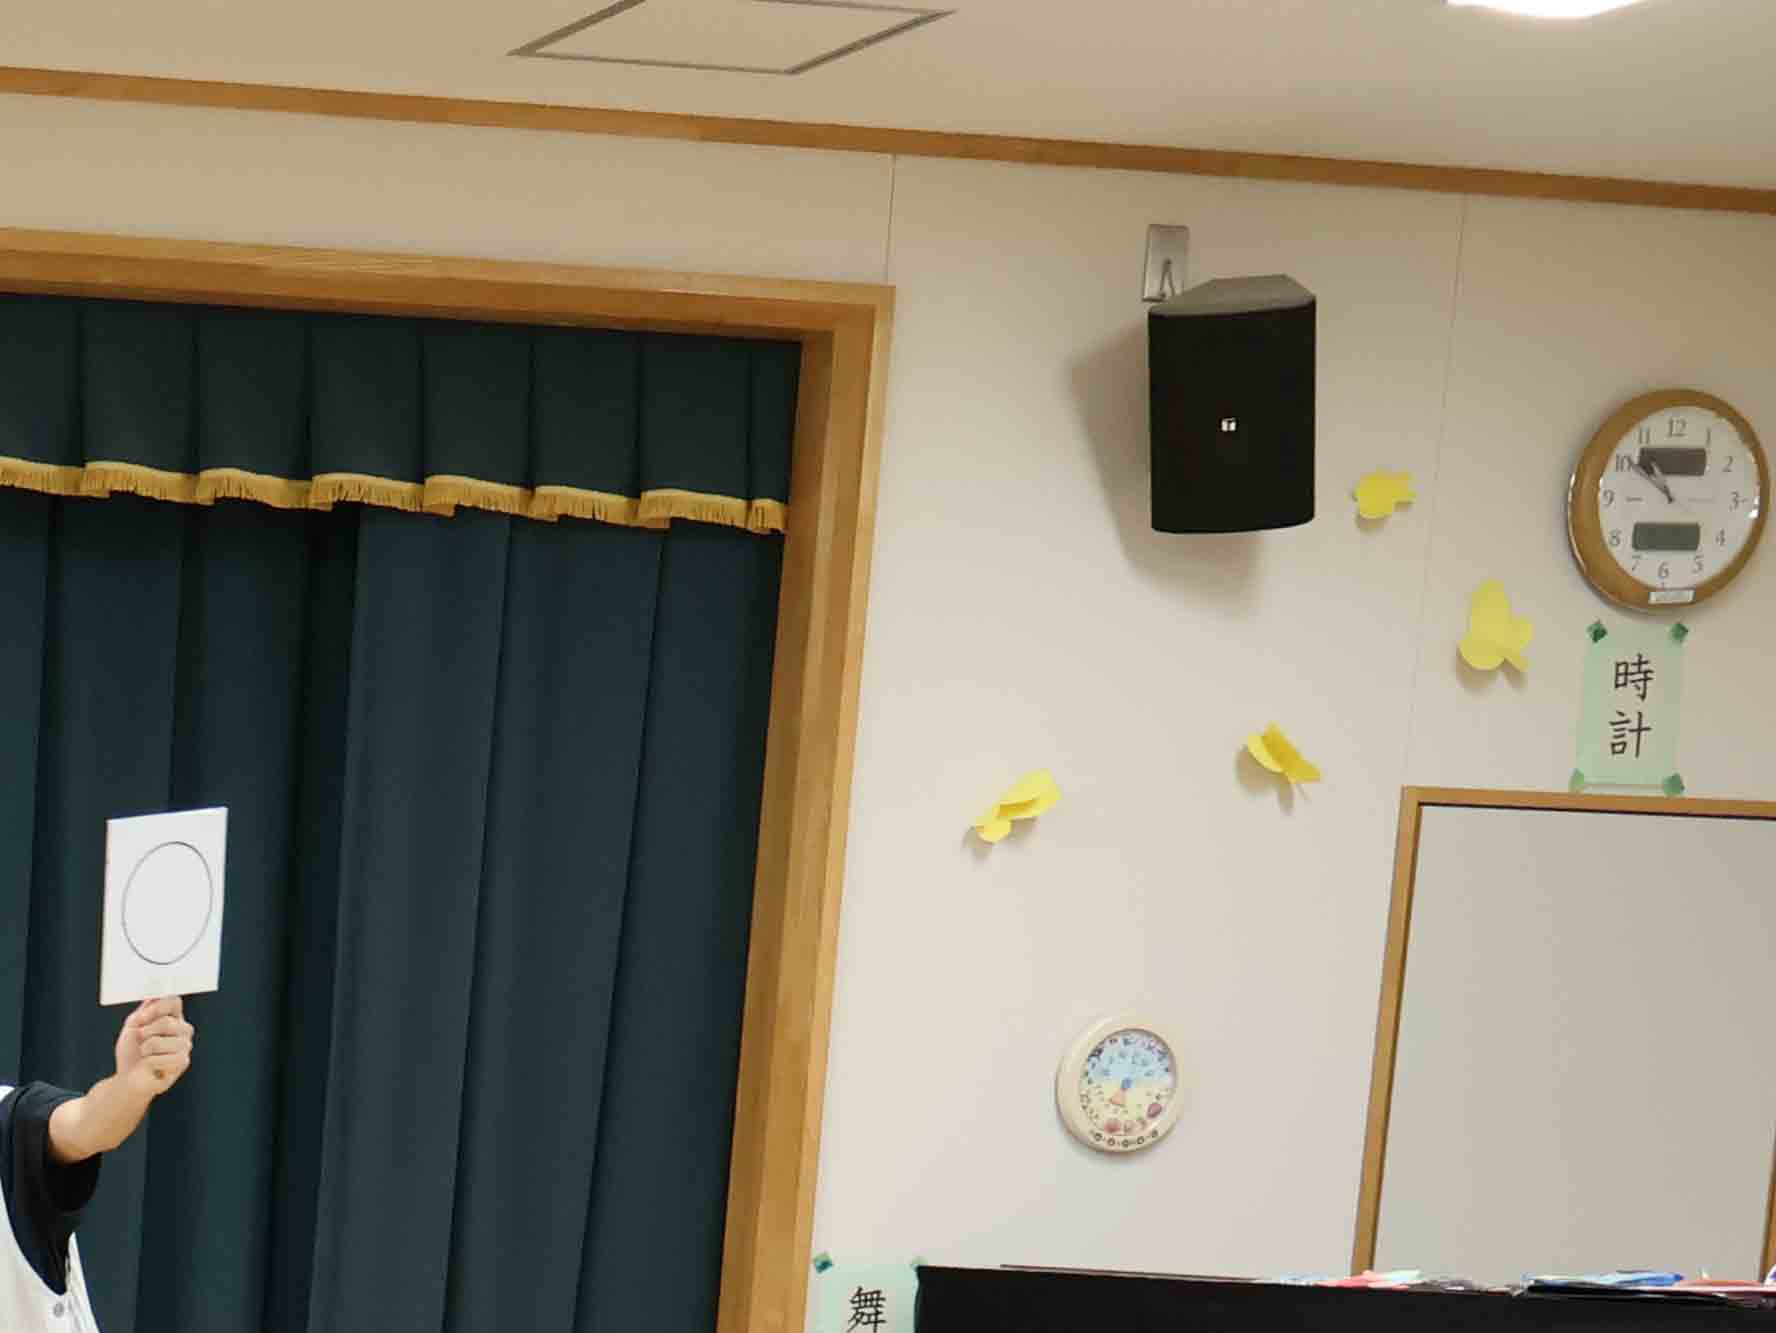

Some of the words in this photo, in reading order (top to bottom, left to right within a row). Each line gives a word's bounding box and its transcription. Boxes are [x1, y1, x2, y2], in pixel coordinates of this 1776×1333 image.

[1668, 417, 1688, 438] 12
[1722, 455, 1734, 473] 2
[1602, 489, 1615, 508] 9
[1729, 490, 1740, 513] 3
[1608, 529, 1621, 548] 8
[1715, 529, 1726, 547] 4
[1631, 553, 1641, 572] 7
[1657, 561, 1670, 579] 6
[1693, 553, 1704, 574] 5
[1609, 653, 1654, 759] 時計
